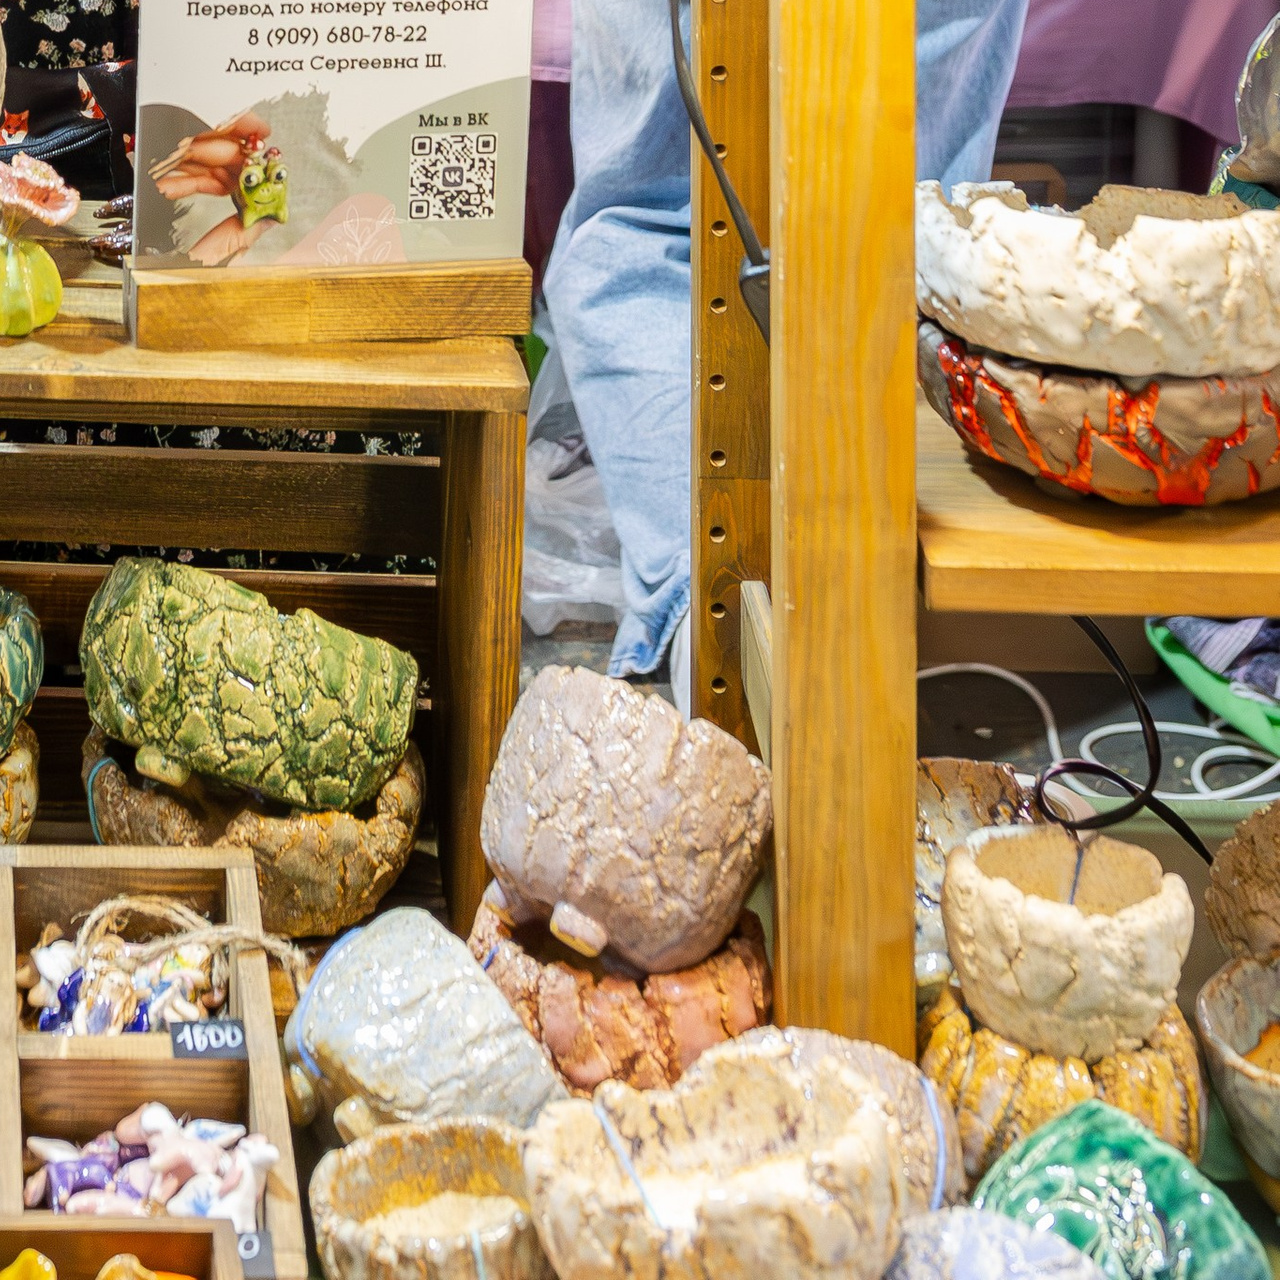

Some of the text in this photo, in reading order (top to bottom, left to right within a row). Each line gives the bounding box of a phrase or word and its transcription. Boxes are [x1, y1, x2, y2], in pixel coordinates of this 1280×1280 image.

[186, 2, 274, 19] Перевод
[280, 3, 304, 14] по
[310, 1, 386, 16] номеру
[248, 25, 427, 47] 8 (909) 680-78-22
[226, 53, 447, 75] Лариса Сергеевна Ш.
[418, 113, 489, 127] Мы в ВК
